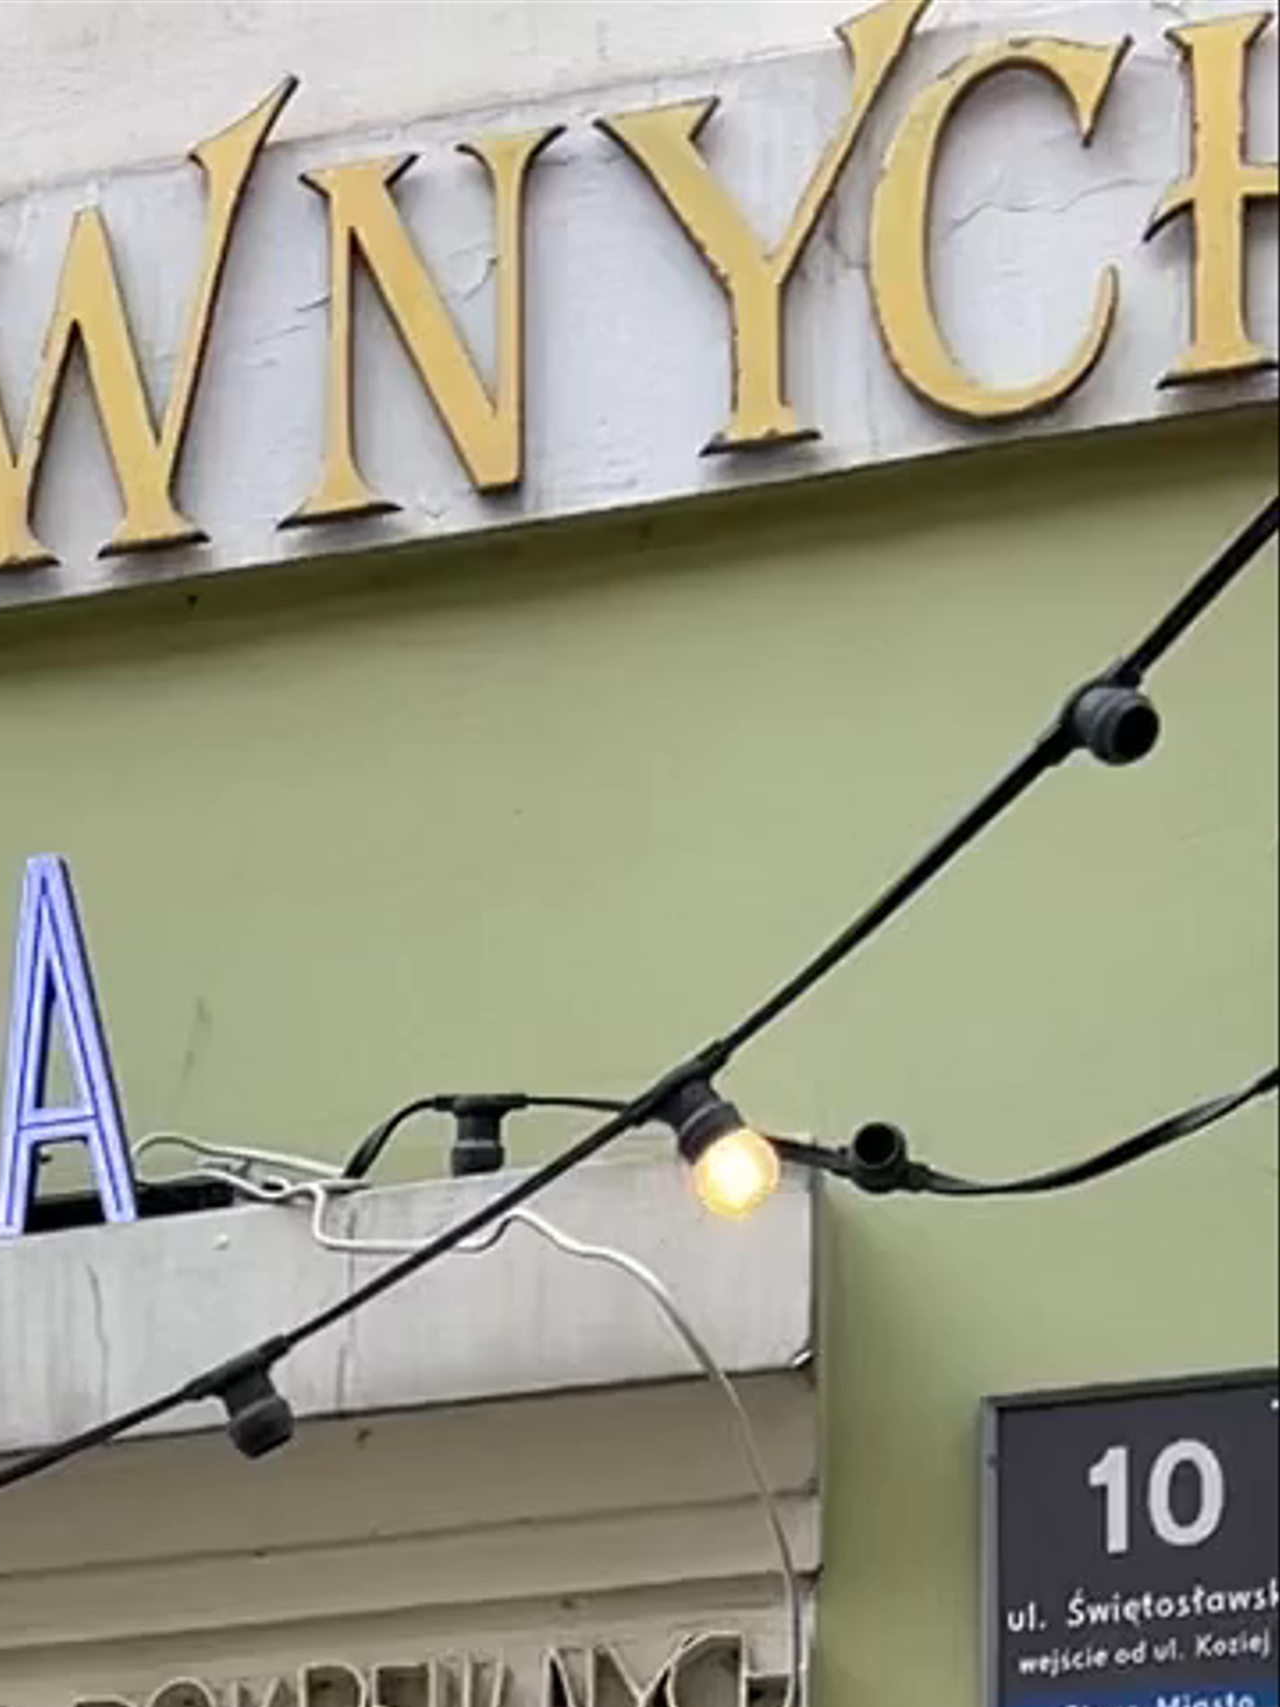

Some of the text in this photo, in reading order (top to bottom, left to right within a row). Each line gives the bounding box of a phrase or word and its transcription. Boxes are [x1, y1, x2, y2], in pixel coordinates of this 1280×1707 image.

[1088, 1437, 1225, 1555] 10
[1007, 1600, 1046, 1632] ul.
[1018, 1628, 1271, 1678] wejście od ul. Koziej
